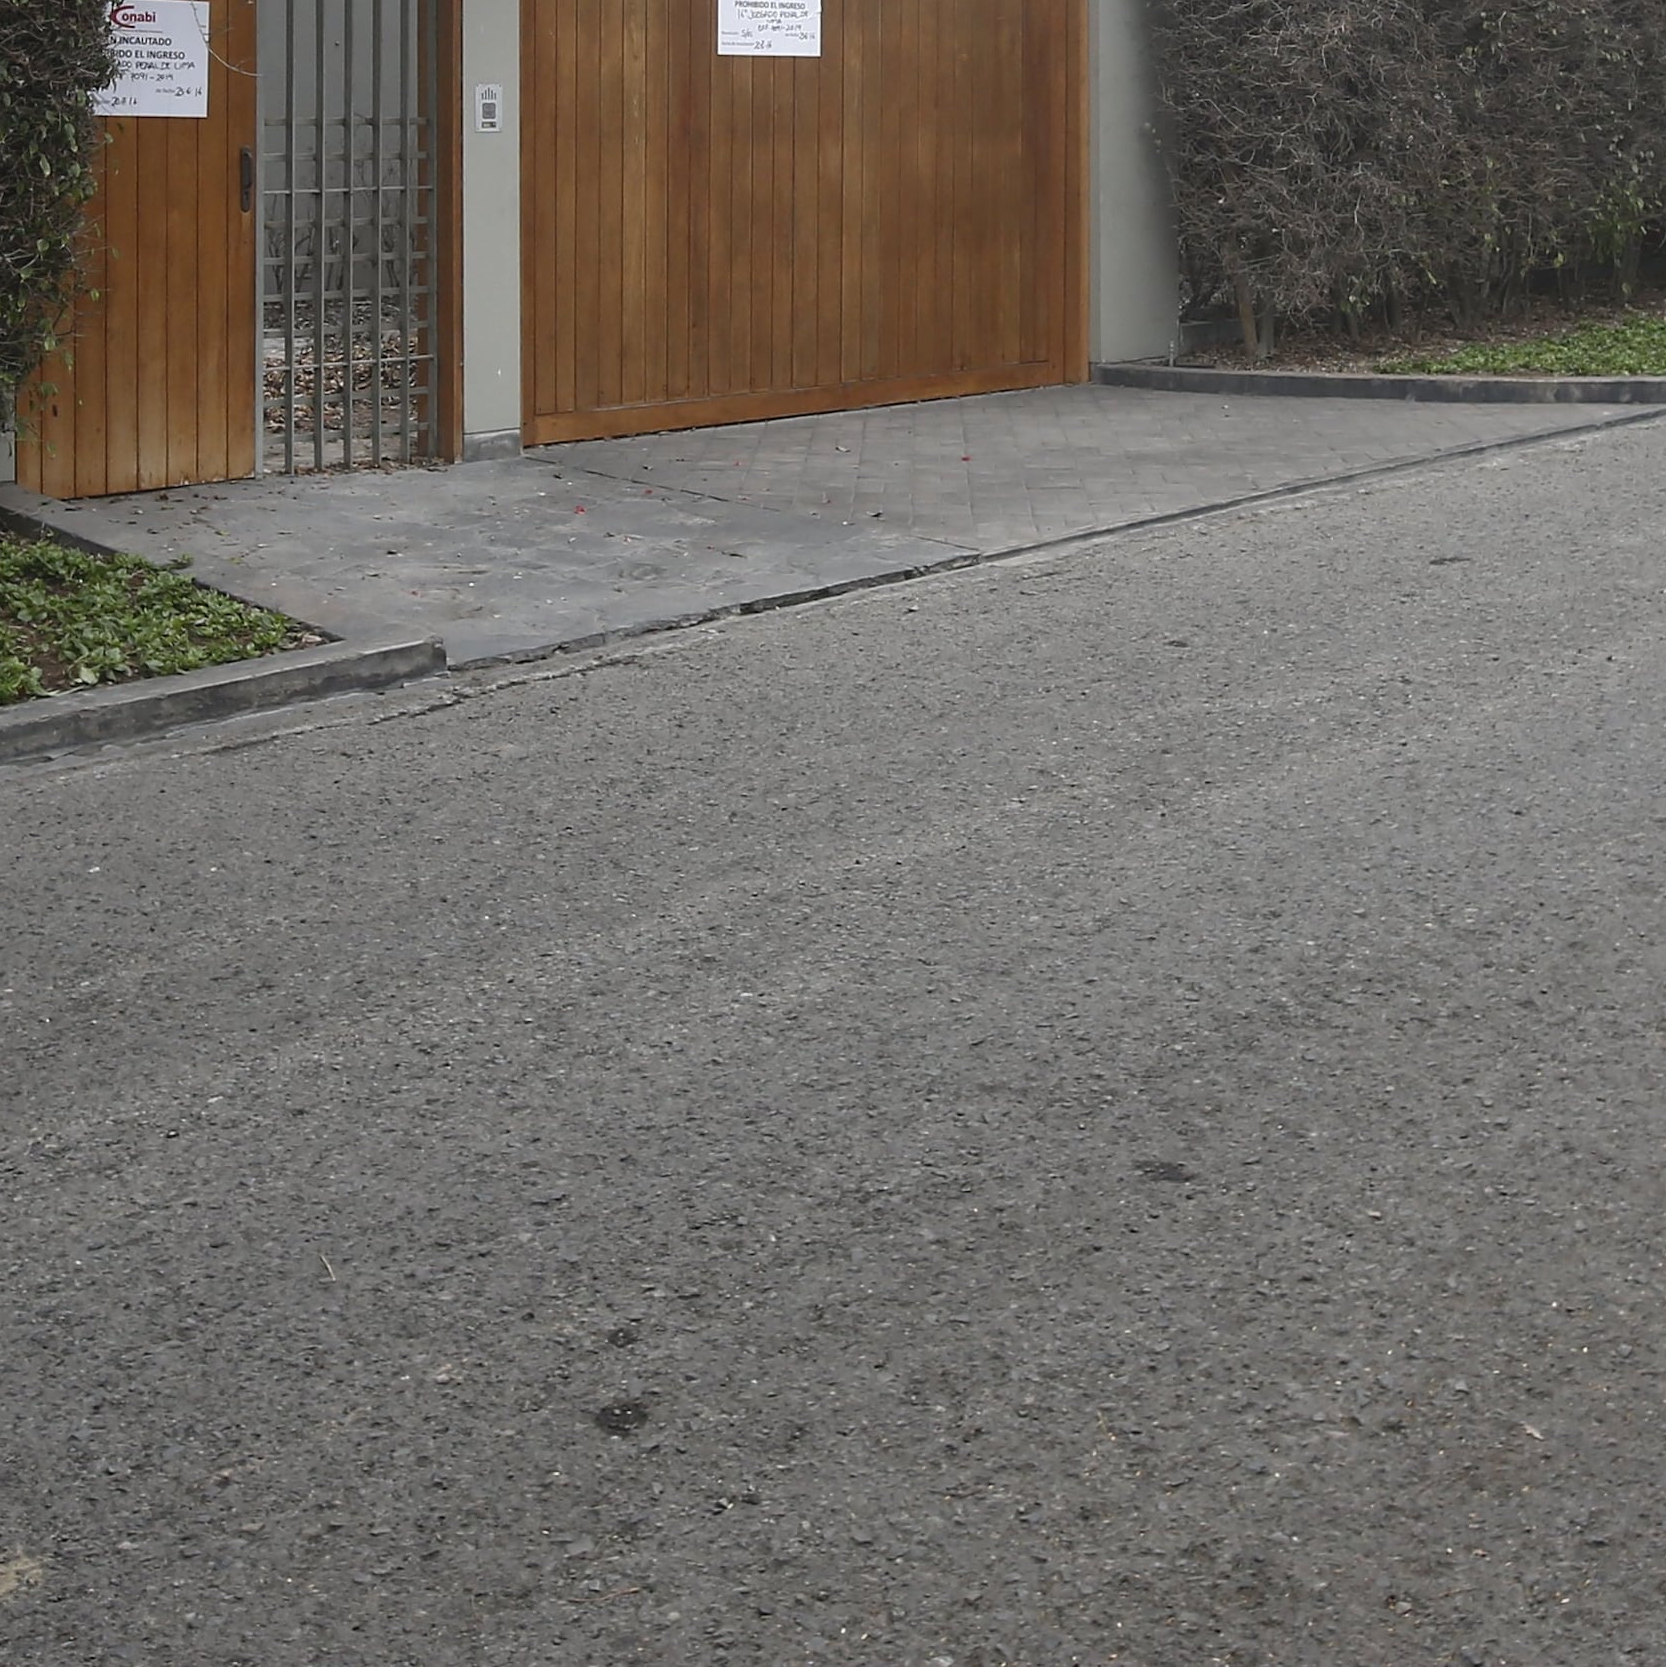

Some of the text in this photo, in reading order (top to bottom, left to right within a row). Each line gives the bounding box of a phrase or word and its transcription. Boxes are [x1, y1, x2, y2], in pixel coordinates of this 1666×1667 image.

[734, 0, 806, 10] PROHIBIDO EL INGRESO
[110, 5, 156, 29] Conabi
[119, 36, 172, 46] INCAUTADO
[134, 50, 145, 58] EL
[146, 50, 185, 60] INGRESO
